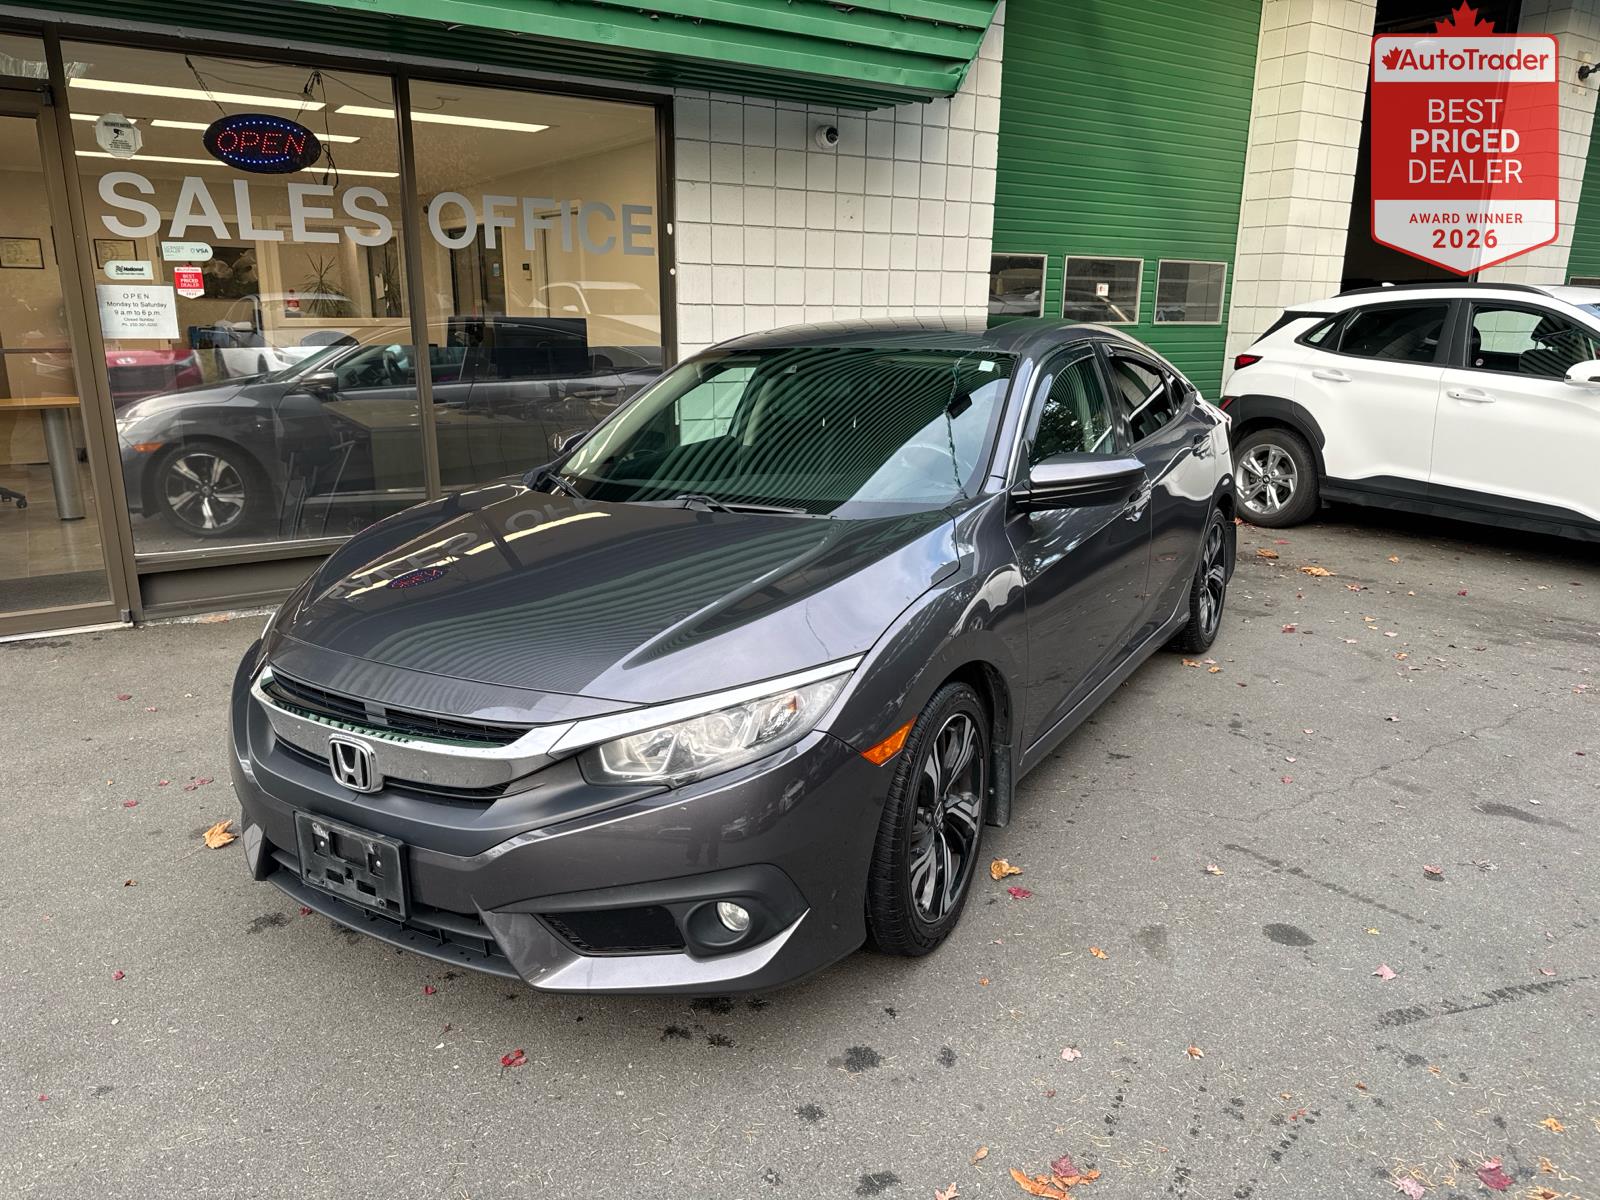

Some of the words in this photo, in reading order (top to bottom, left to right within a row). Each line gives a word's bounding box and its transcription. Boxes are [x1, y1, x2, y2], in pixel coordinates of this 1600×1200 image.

[217, 130, 306, 155] OPEN
[98, 171, 393, 247] SALES
[427, 191, 655, 257] OFFICE
[140, 301, 167, 309] Saturday
